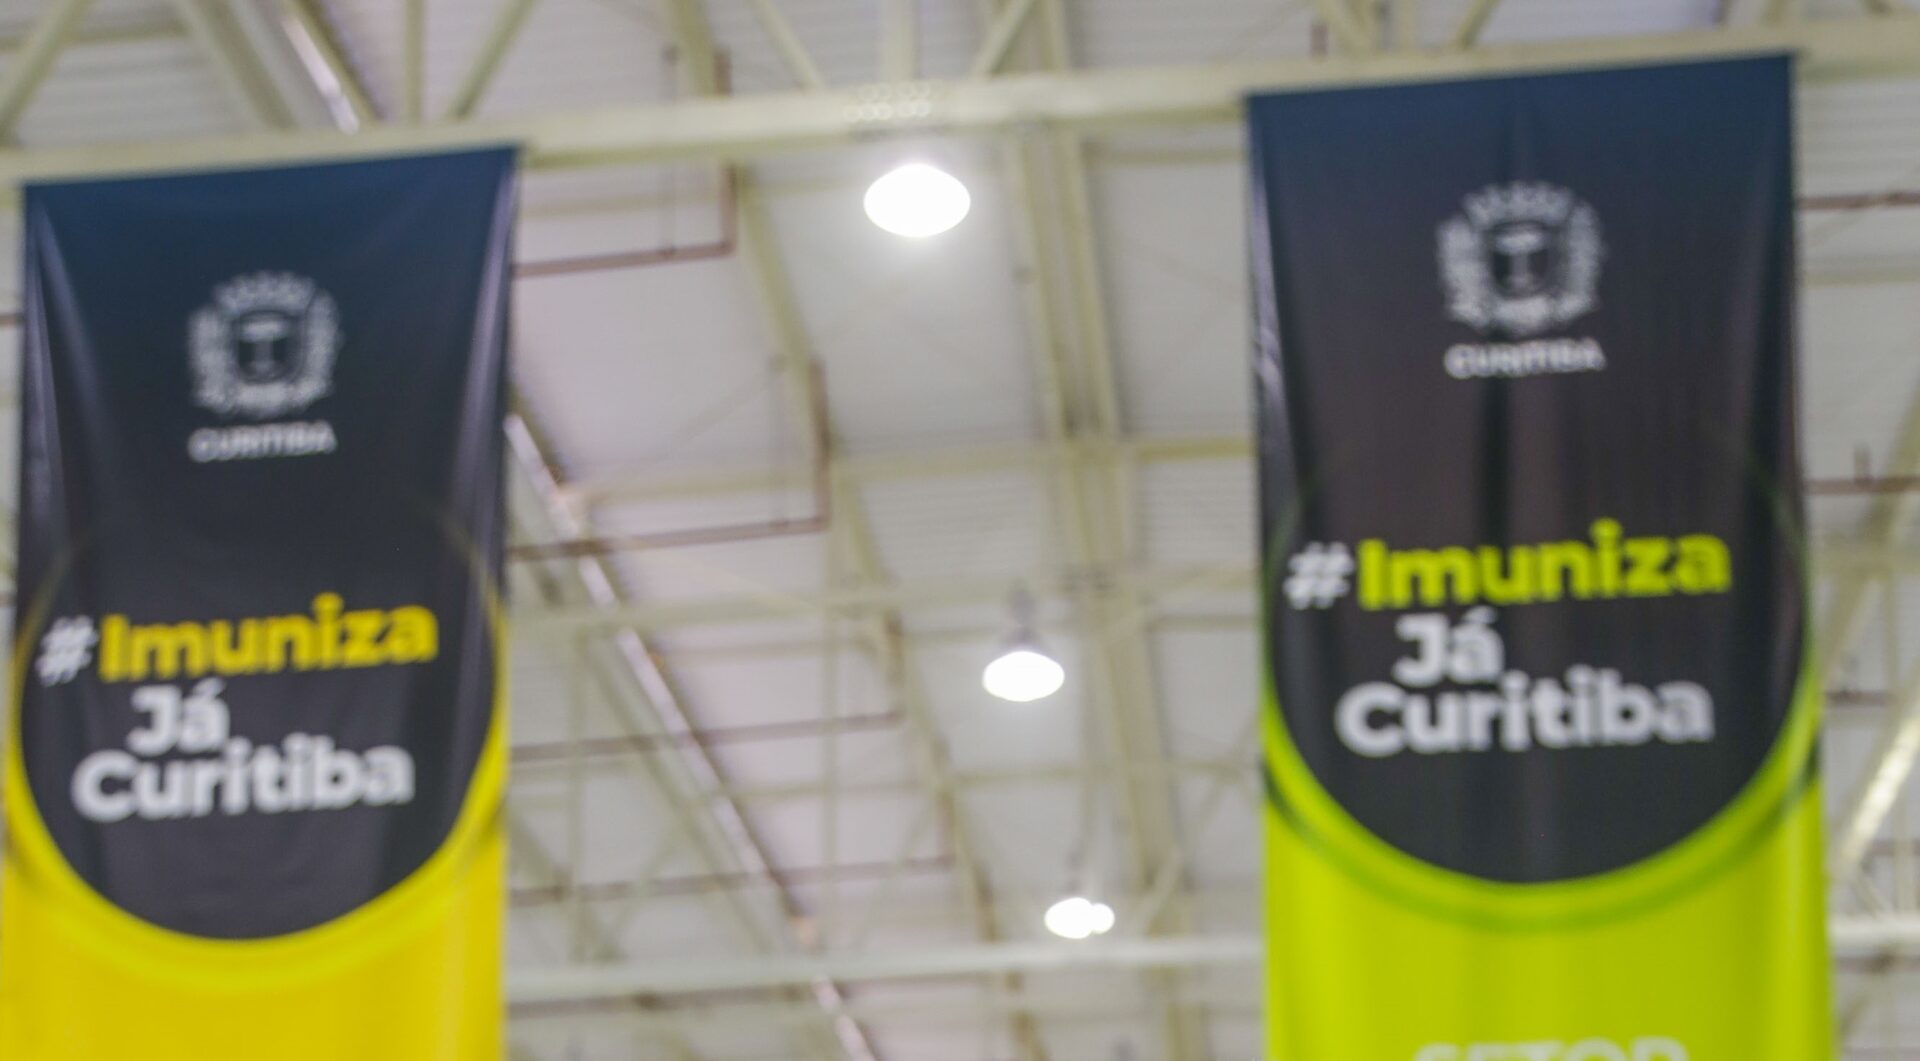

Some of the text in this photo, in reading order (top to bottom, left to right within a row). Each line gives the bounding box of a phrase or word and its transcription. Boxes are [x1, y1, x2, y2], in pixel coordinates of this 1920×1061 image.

[1284, 518, 1731, 610] #Imuniza
[36, 593, 438, 686] #Imuniza
[1393, 607, 1505, 687] Já
[127, 678, 230, 755] Já
[1334, 665, 1715, 757] Curitiba
[72, 732, 415, 822] Curitiba
